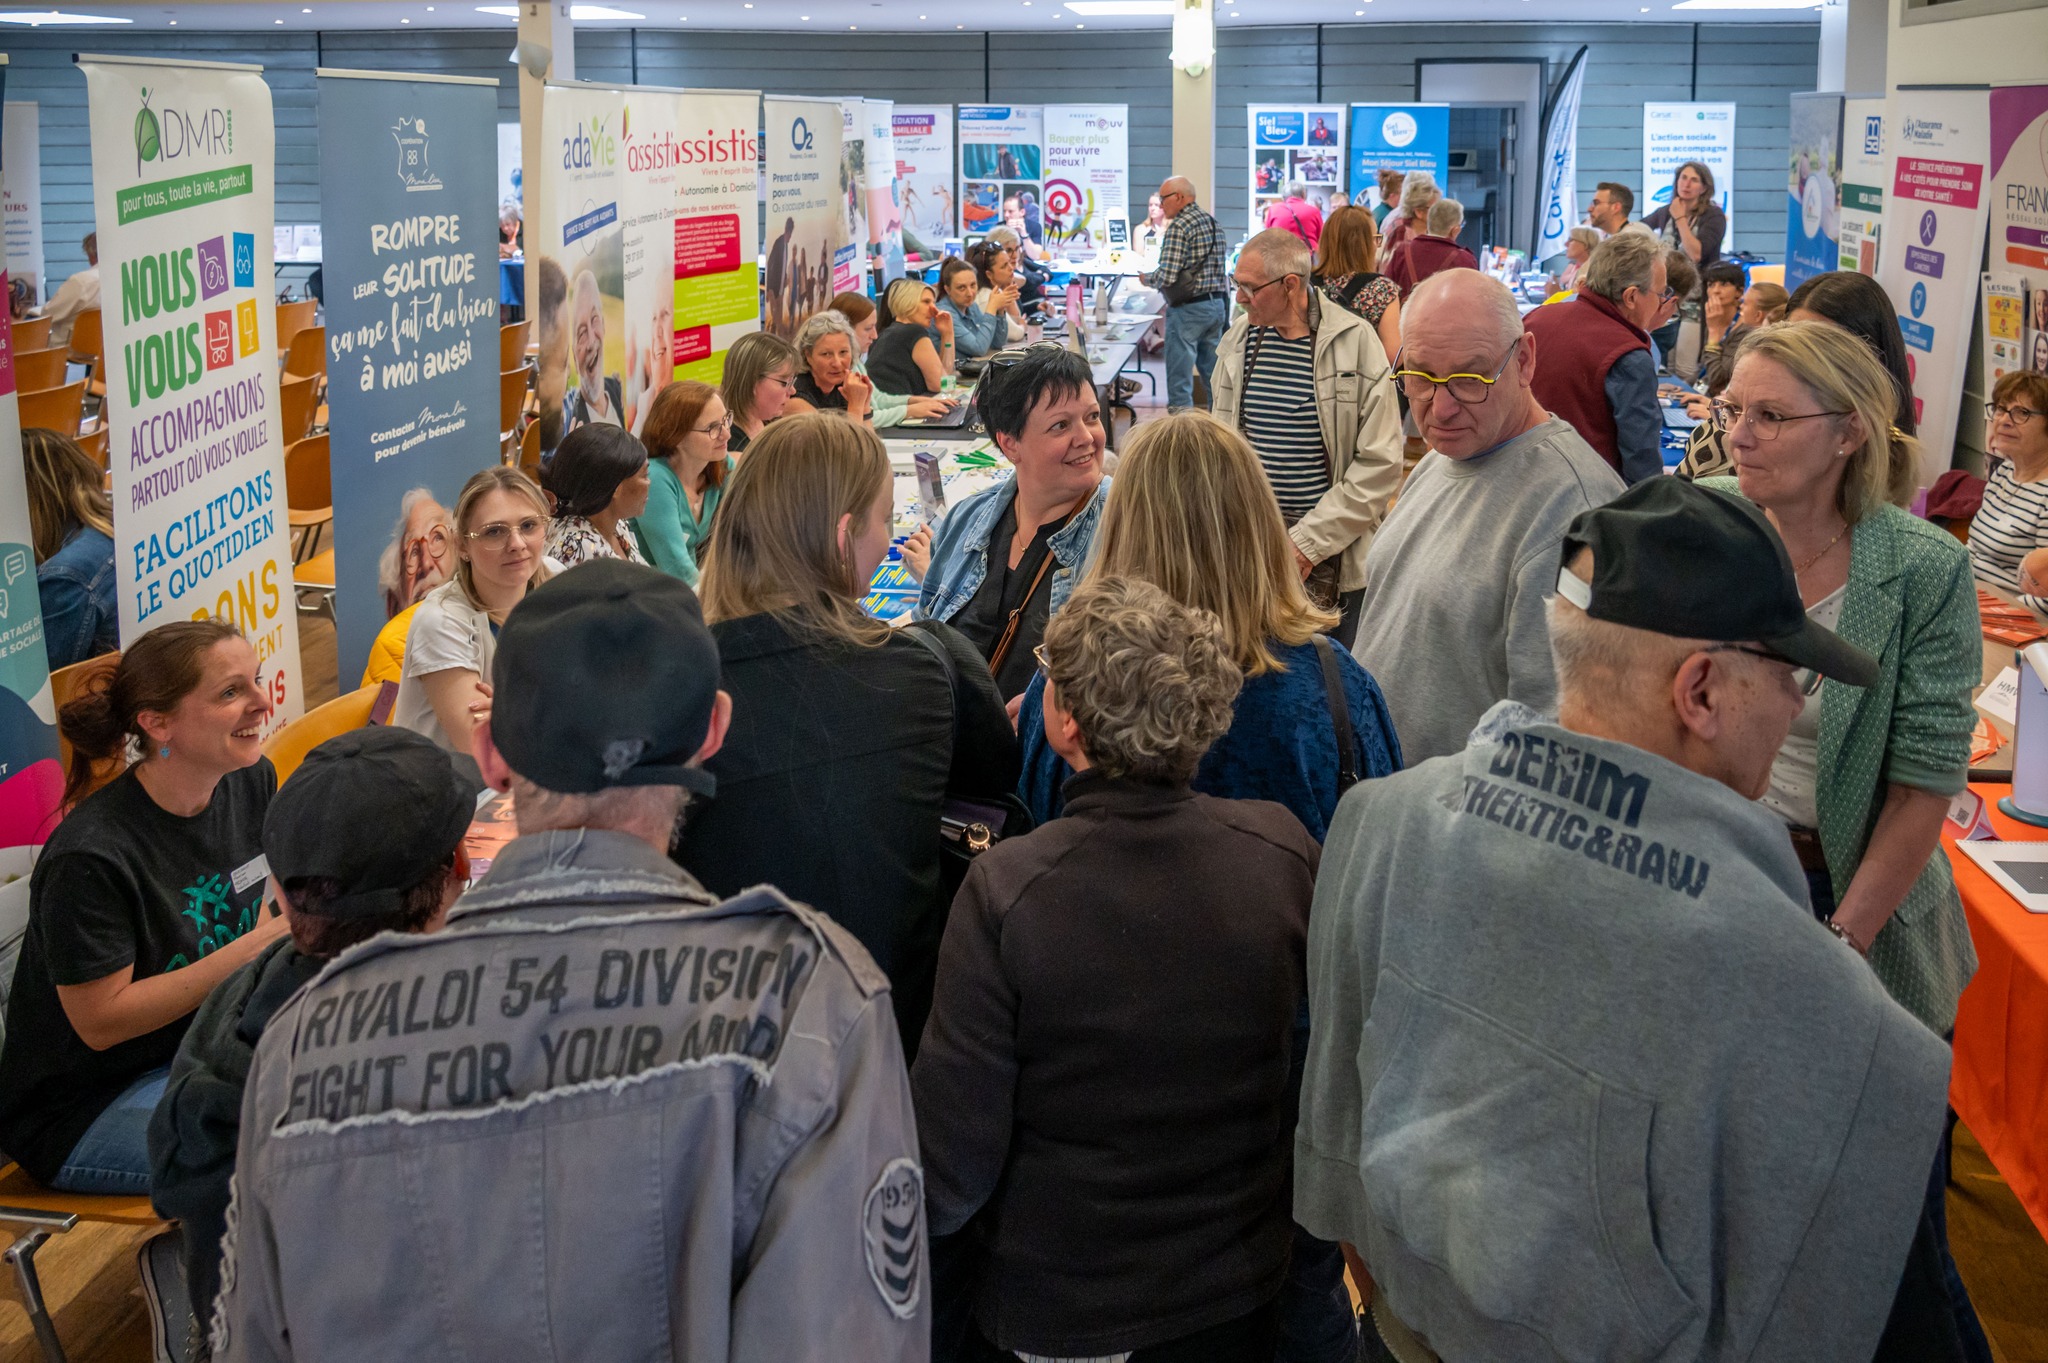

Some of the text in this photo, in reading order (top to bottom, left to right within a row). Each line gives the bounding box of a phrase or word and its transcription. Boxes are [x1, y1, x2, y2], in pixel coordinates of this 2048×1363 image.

[1258, 116, 1276, 126] Siel
[1265, 125, 1287, 135] Bleu
[1049, 134, 1110, 145] Bouger plus
[1651, 133, 1716, 141] L'action sociale
[407, 149, 418, 165] 88
[1049, 145, 1100, 157] pour vivre
[1672, 145, 1728, 153] accompagne
[1049, 157, 1086, 167] mieux !
[1380, 158, 1403, 168] Séjour
[1909, 161, 1964, 176] LE SERVICE PRÉVENTION
[772, 171, 820, 182] Prenez du temps
[1904, 173, 1912, 182] VOS
[1926, 176, 1940, 186] POUR
[1940, 178, 1960, 190] PRENDRE
[1961, 180, 1974, 192] SOIN
[123, 171, 246, 218] pour tous, toute la vie, partout
[680, 184, 719, 197] Autonomie
[722, 184, 728, 194] à
[772, 189, 788, 200] pour
[1914, 188, 1921, 197] DE
[1921, 189, 1935, 200] VOTRE
[1935, 190, 1950, 202] SANTÉ
[2006, 213, 2031, 224] RÉSEAU
[371, 214, 460, 256] ROMPRE
[121, 247, 197, 327] NOUS
[353, 253, 476, 300] LEUR SOLITUDE
[331, 287, 497, 362] ça me fait du bien
[124, 322, 203, 409] VOUS
[360, 328, 472, 392] à moi aussi
[130, 372, 265, 472] ACCOMPAGNONS
[374, 418, 466, 463] pour devenir bénévole
[131, 419, 268, 514] PARTOUT OÙ VOUS VOULEZ
[133, 469, 274, 582] FACILITONS
[137, 509, 275, 624] LE QUOTIDIEN
[10, 628, 42, 654] SOCIALE
[1488, 731, 1651, 829] DENIM
[301, 943, 809, 1054] RIVALDI 54 DIVISION
[288, 1054, 407, 1122] FIGHT
[420, 1041, 512, 1112] FOR
[540, 1024, 663, 1090] YOUR
